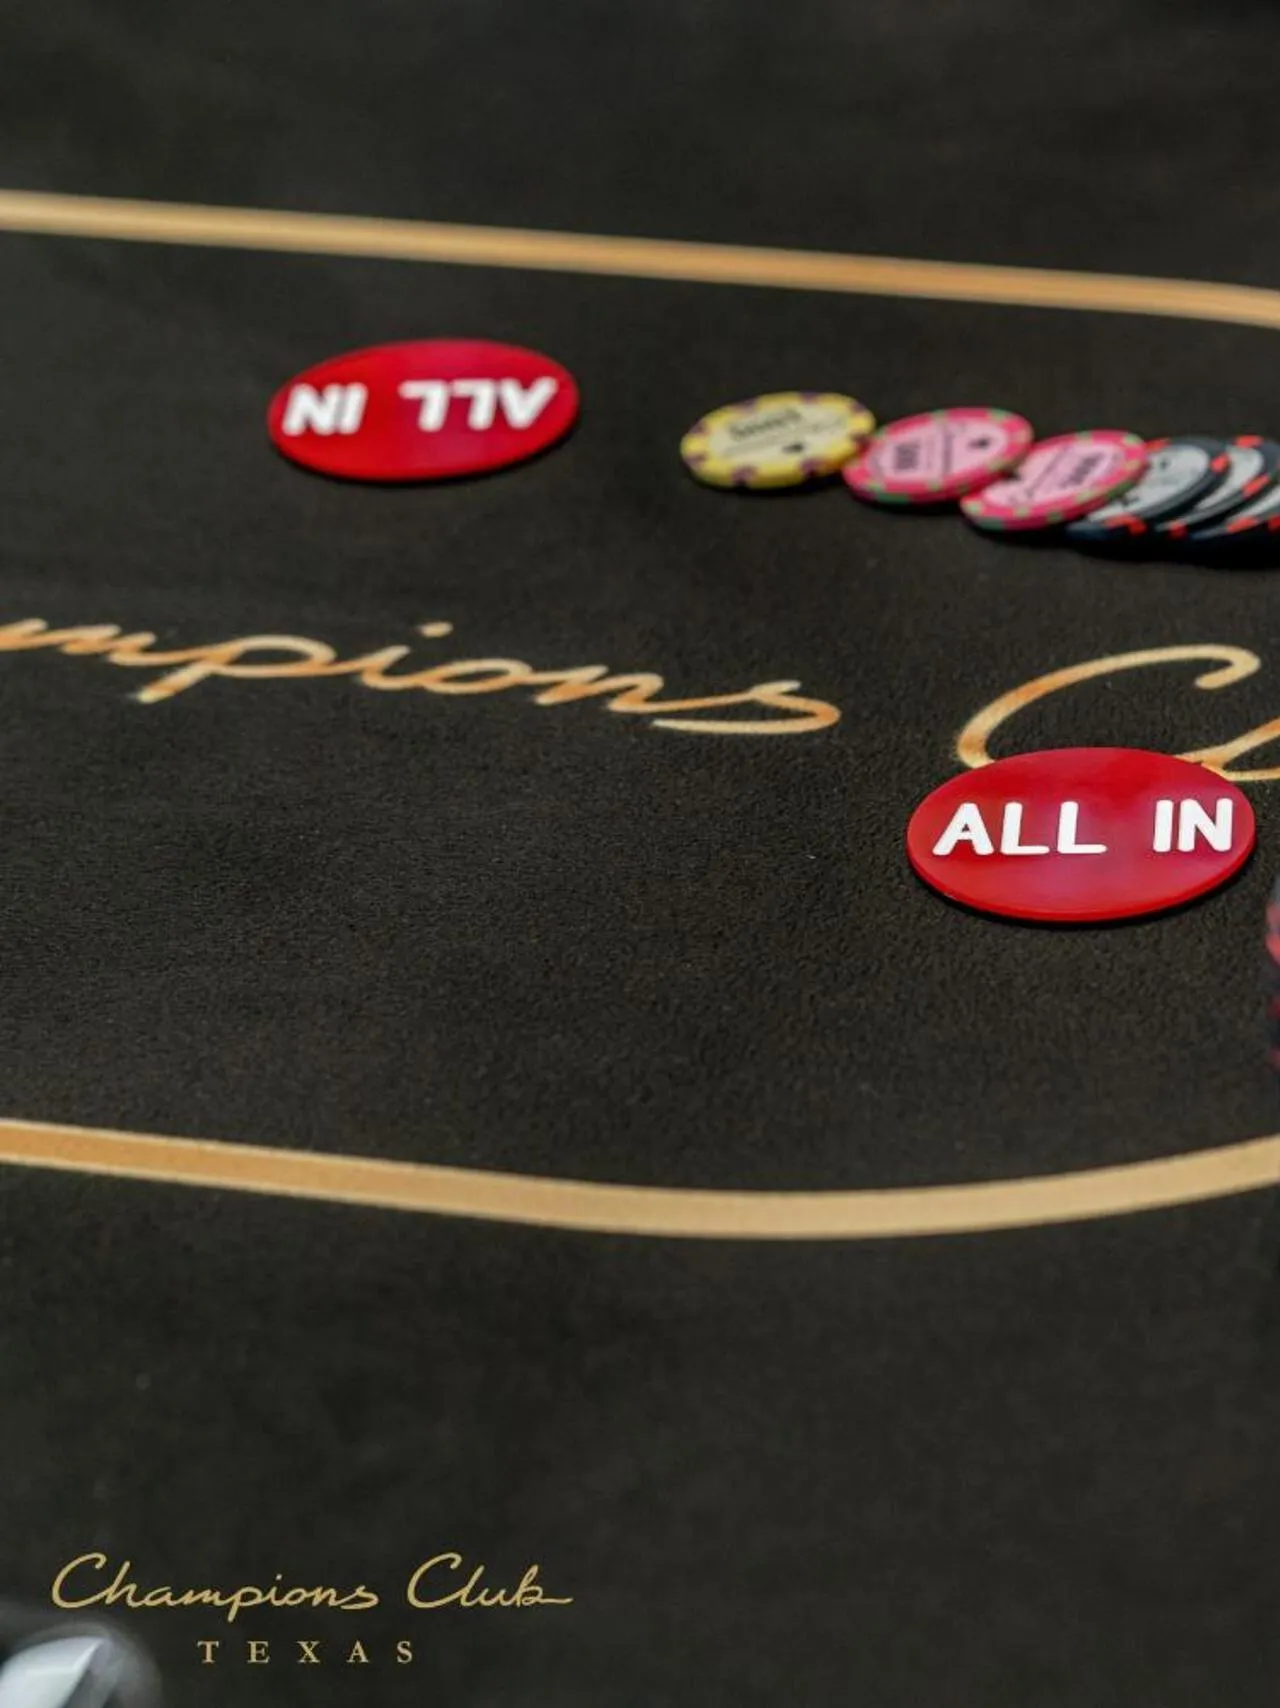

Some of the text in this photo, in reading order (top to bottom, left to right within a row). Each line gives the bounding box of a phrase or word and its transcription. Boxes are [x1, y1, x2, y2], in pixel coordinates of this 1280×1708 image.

[282, 376, 558, 436] ALL IN
[932, 797, 1234, 857] ALL IN
